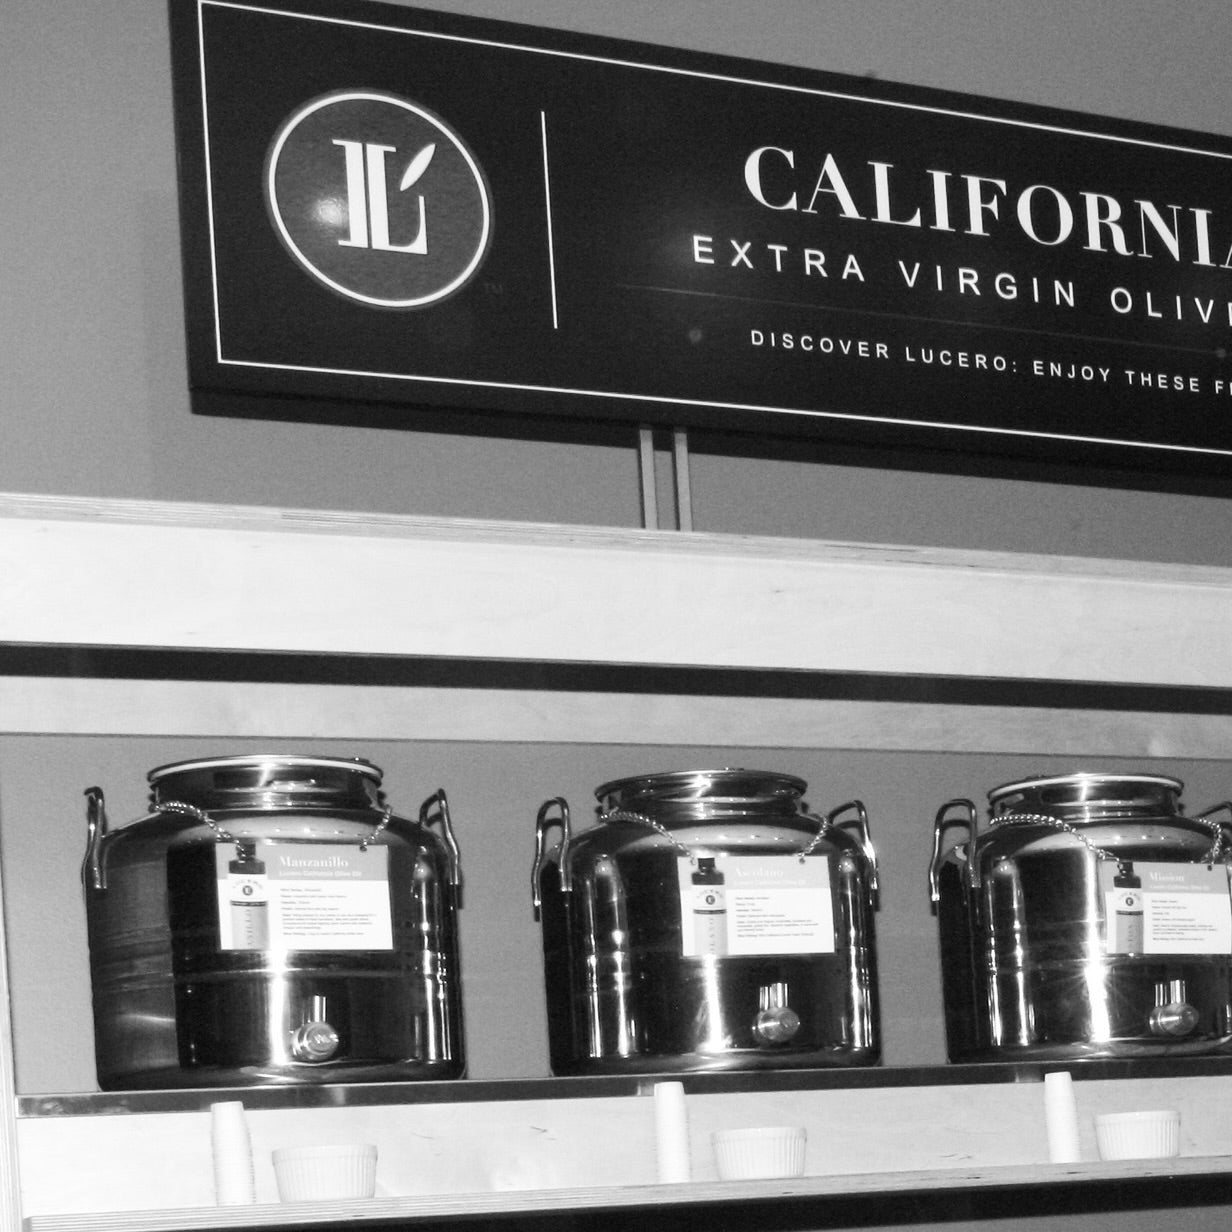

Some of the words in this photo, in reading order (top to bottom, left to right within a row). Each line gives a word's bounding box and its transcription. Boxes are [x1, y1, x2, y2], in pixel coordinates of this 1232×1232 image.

[692, 234, 866, 282] EXTRA
[898, 260, 1076, 308] VIRGIN
[750, 329, 890, 359] DISCOVER
[905, 346, 1018, 373] LUCERO:
[1033, 360, 1111, 383] ENJOY
[1125, 370, 1200, 393] THESE
[279, 855, 350, 868] Manzanillo
